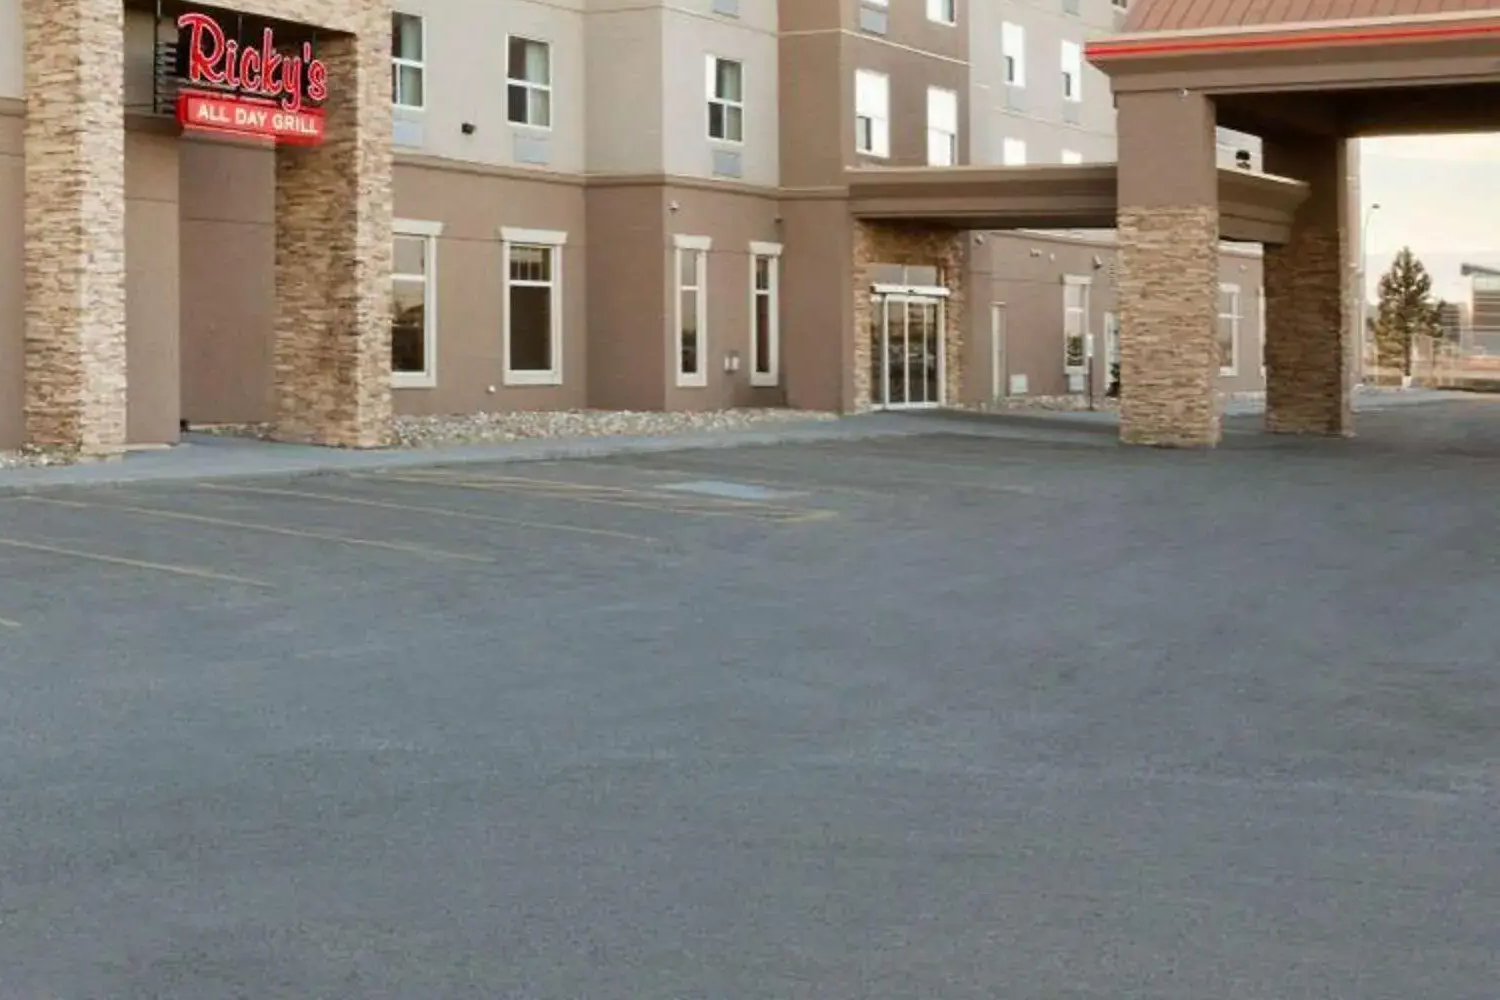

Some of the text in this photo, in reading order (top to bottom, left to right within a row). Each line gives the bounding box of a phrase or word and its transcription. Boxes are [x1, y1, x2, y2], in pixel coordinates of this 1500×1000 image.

[177, 12, 328, 113] Ricky's
[197, 104, 319, 134] ALL DAY GRILL
